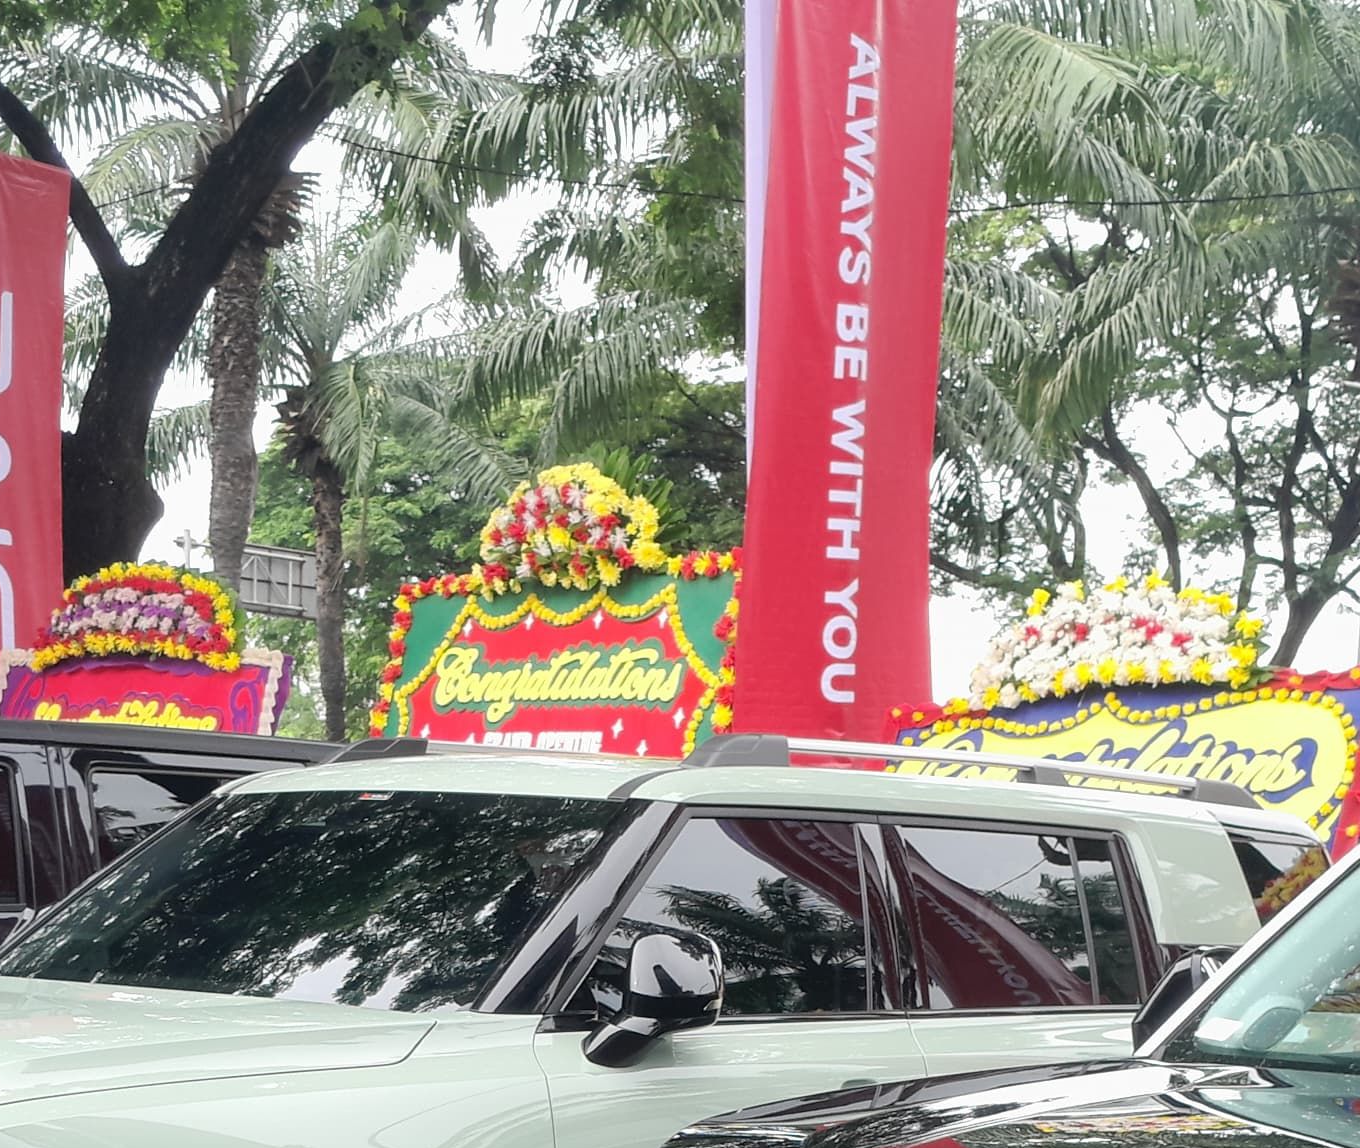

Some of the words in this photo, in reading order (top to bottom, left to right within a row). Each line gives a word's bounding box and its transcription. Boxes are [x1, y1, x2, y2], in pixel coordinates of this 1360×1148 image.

[835, 32, 881, 286] ALWAYS
[832, 303, 870, 382] BE
[825, 397, 867, 562] WITH
[434, 647, 683, 723] Congratulations
[820, 576, 860, 704] YOU
